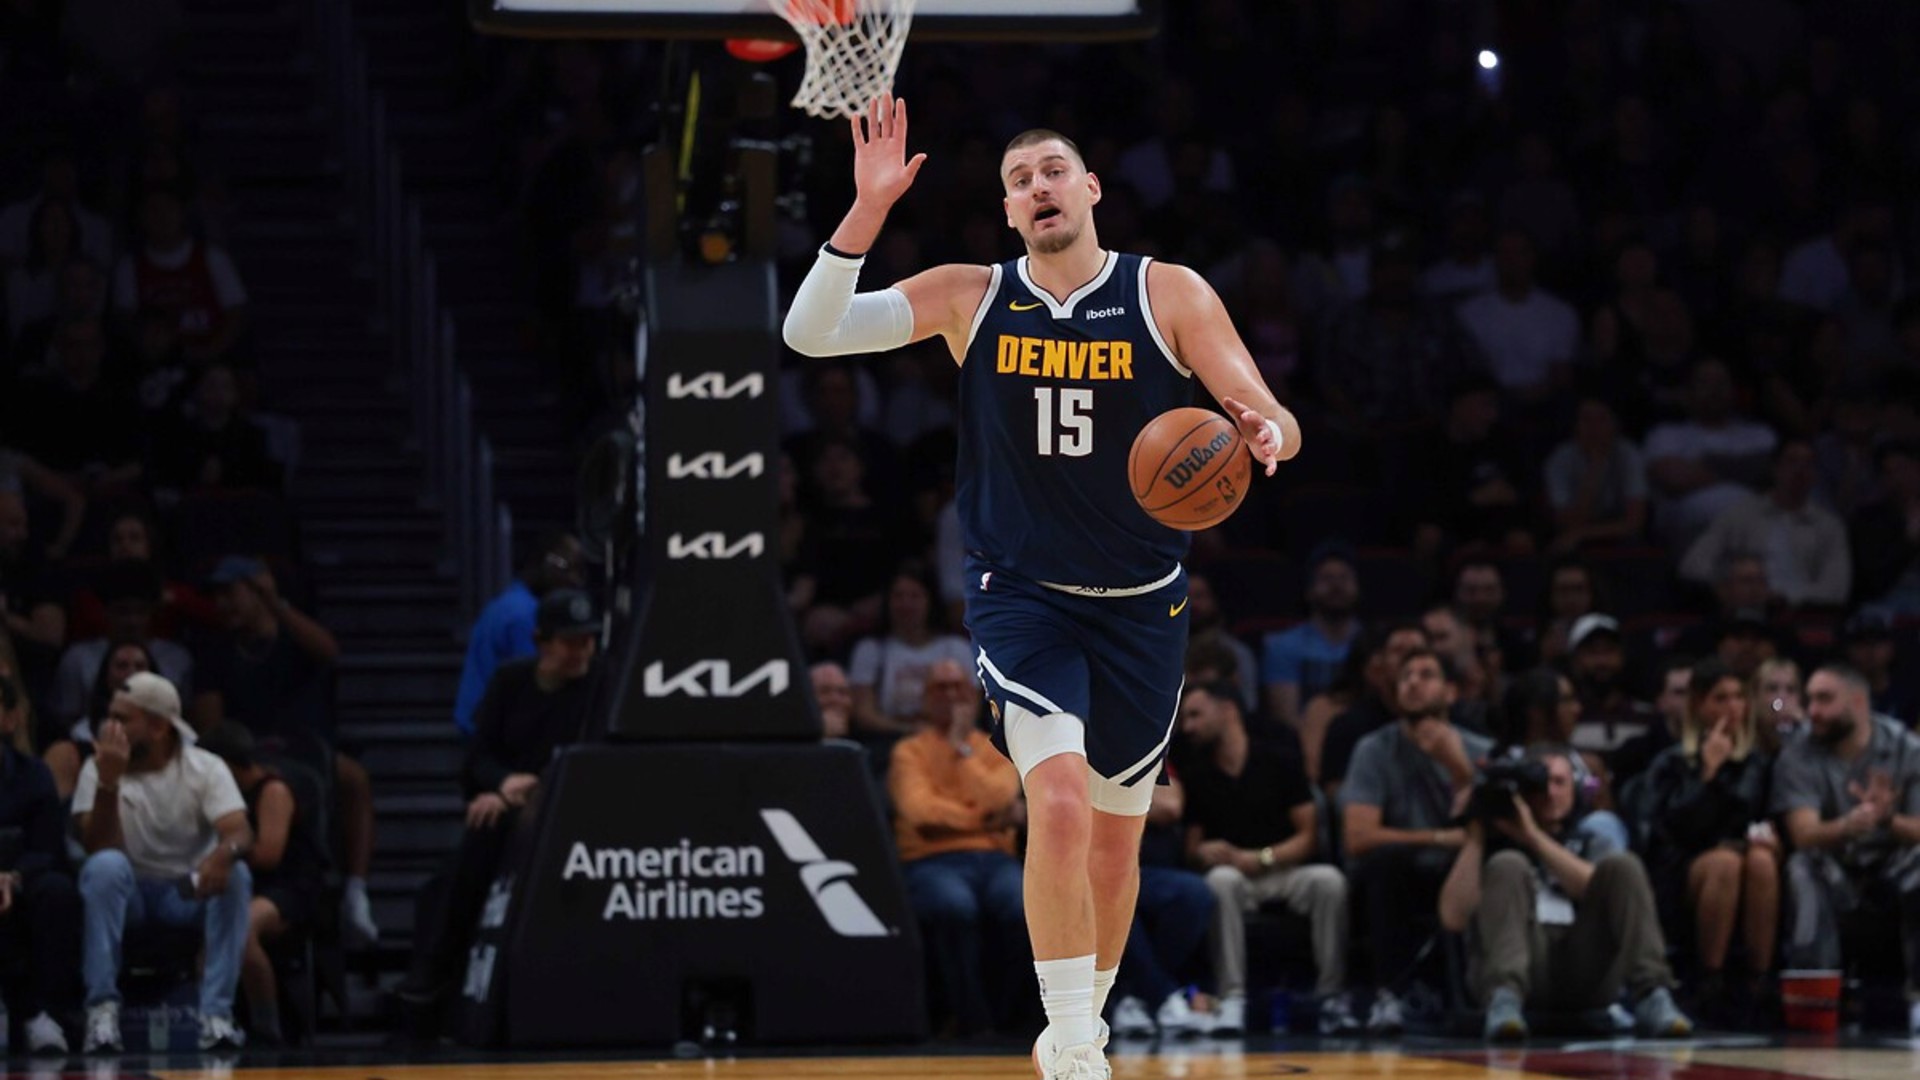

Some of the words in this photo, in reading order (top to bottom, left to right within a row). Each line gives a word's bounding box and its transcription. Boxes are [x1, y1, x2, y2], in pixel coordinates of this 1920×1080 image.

[1086, 306, 1125, 321] ibotta
[997, 335, 1134, 380] DENVER
[667, 372, 764, 399] KIA
[1034, 387, 1093, 457] 15
[667, 452, 764, 479] KIA
[1164, 431, 1232, 489] Wilson
[667, 532, 764, 559] KIA
[644, 660, 789, 697] KIA
[563, 838, 764, 880] American
[603, 880, 764, 920] Airlines
